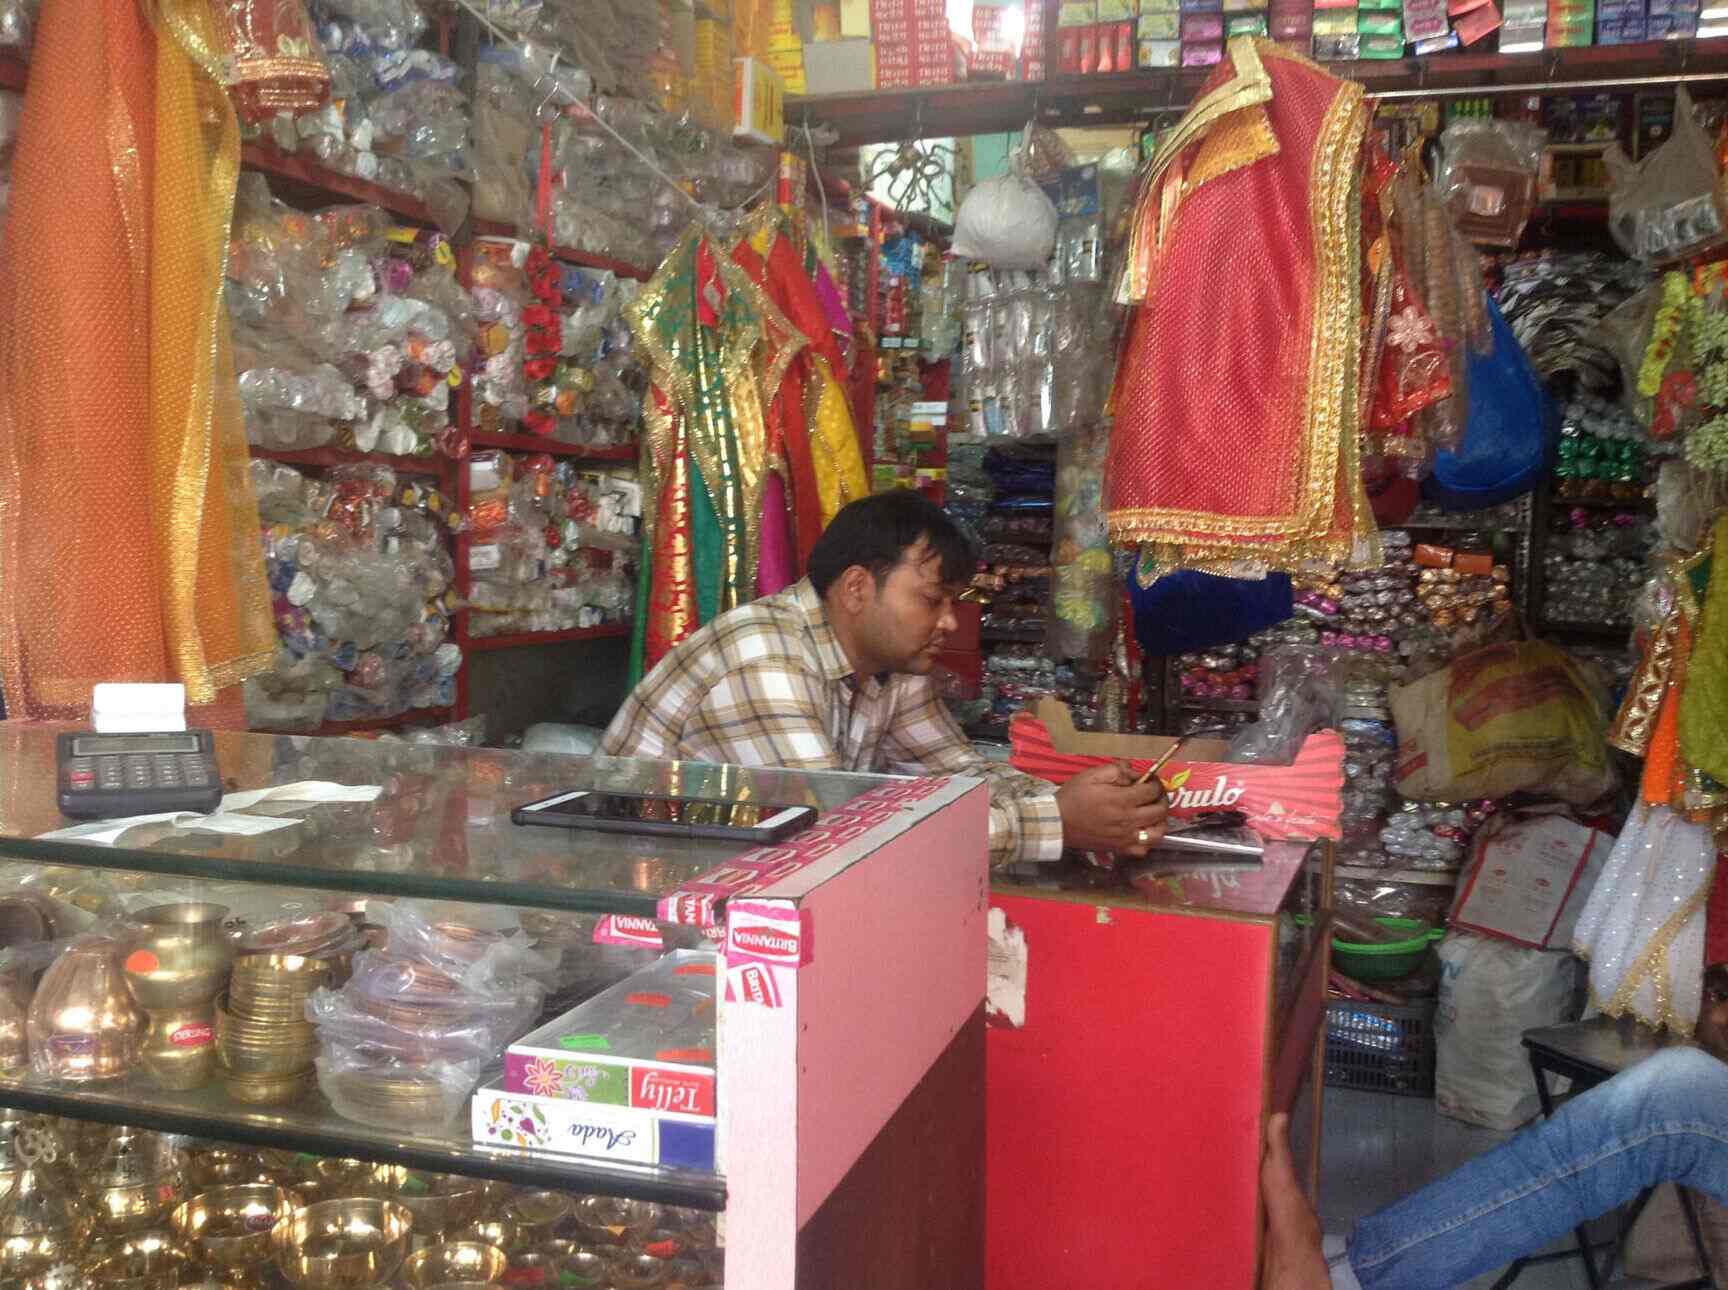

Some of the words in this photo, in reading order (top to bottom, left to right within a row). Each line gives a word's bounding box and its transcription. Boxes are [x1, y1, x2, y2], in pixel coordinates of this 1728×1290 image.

[732, 929, 799, 955] BRITANNIA
[639, 1072, 701, 1112] Telly
[568, 1123, 636, 1151] Aada
